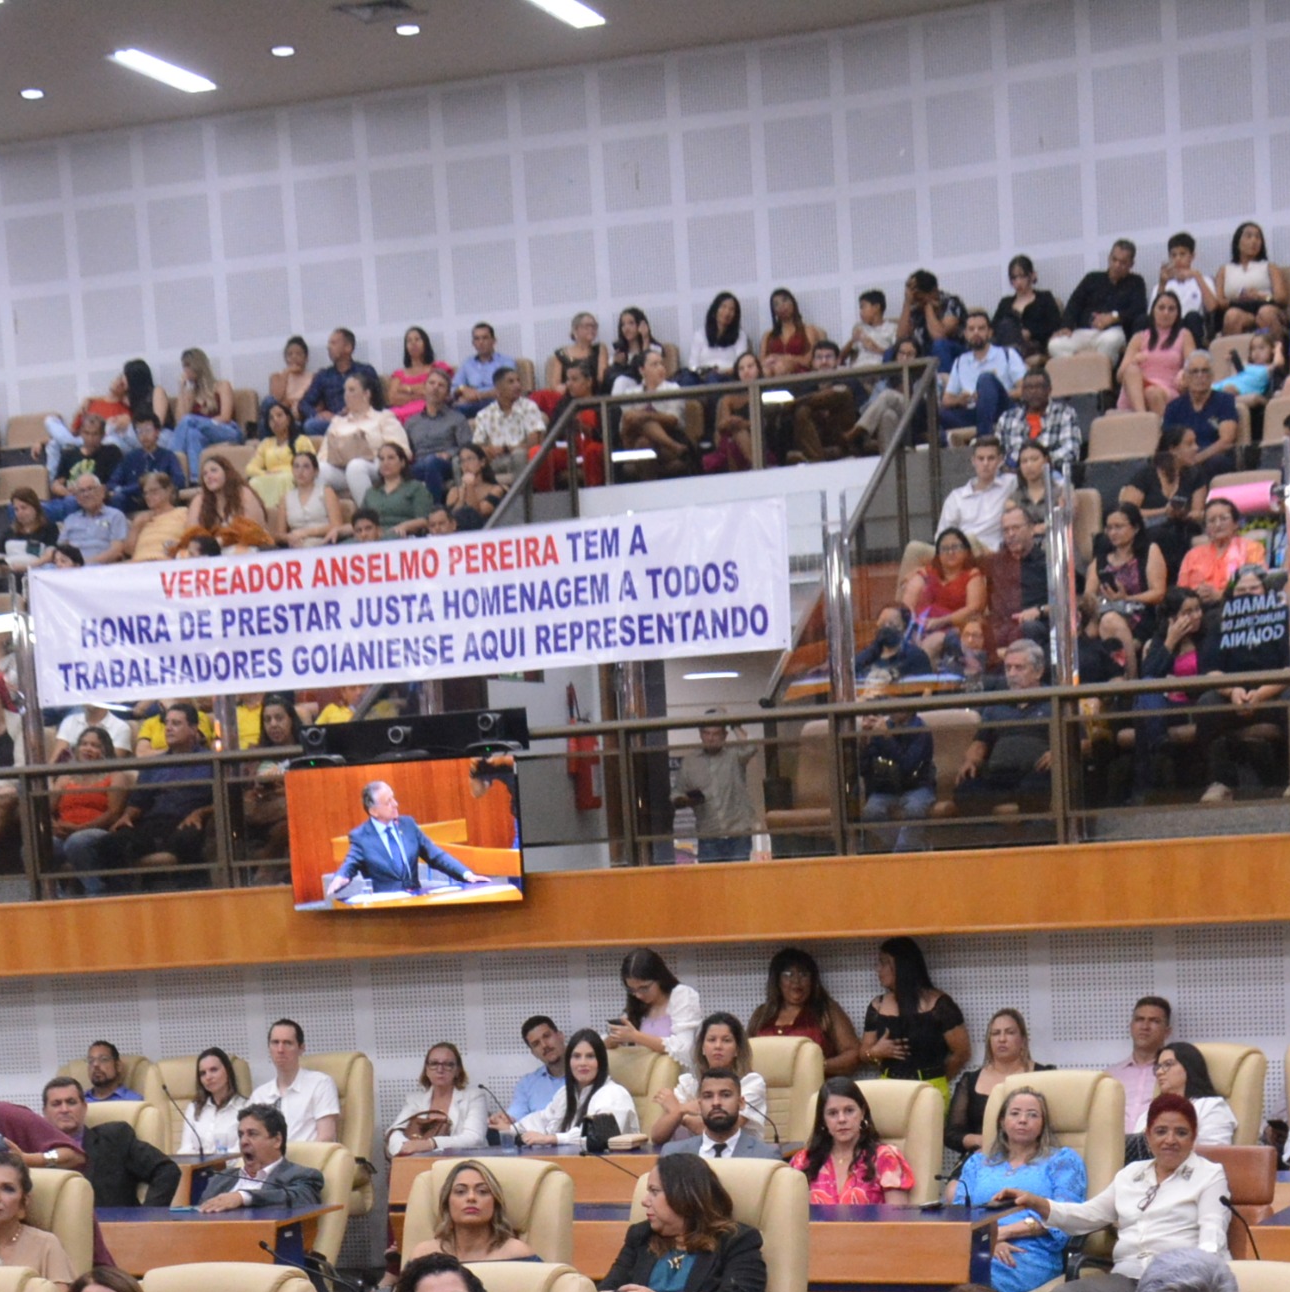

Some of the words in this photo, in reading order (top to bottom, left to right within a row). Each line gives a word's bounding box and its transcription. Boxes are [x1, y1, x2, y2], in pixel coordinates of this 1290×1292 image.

[81, 613, 173, 648] HONRA
[179, 610, 214, 643] DE
[221, 599, 342, 641] PRESTAR
[350, 593, 436, 630] JUSTA
[442, 573, 610, 621] HOMENAGEM
[618, 569, 639, 603] A
[644, 560, 740, 601] TODOS
[160, 560, 303, 599] VEREADOR
[311, 547, 441, 589] ANSELMO
[448, 534, 560, 577] PEREIRA
[566, 527, 620, 564] TEM
[628, 523, 649, 558] A
[57, 648, 283, 692] TRABALHADORES
[292, 635, 455, 676] GOIANIENSE
[463, 627, 526, 662] AQUI
[535, 604, 769, 656] REPRESENTANDO
